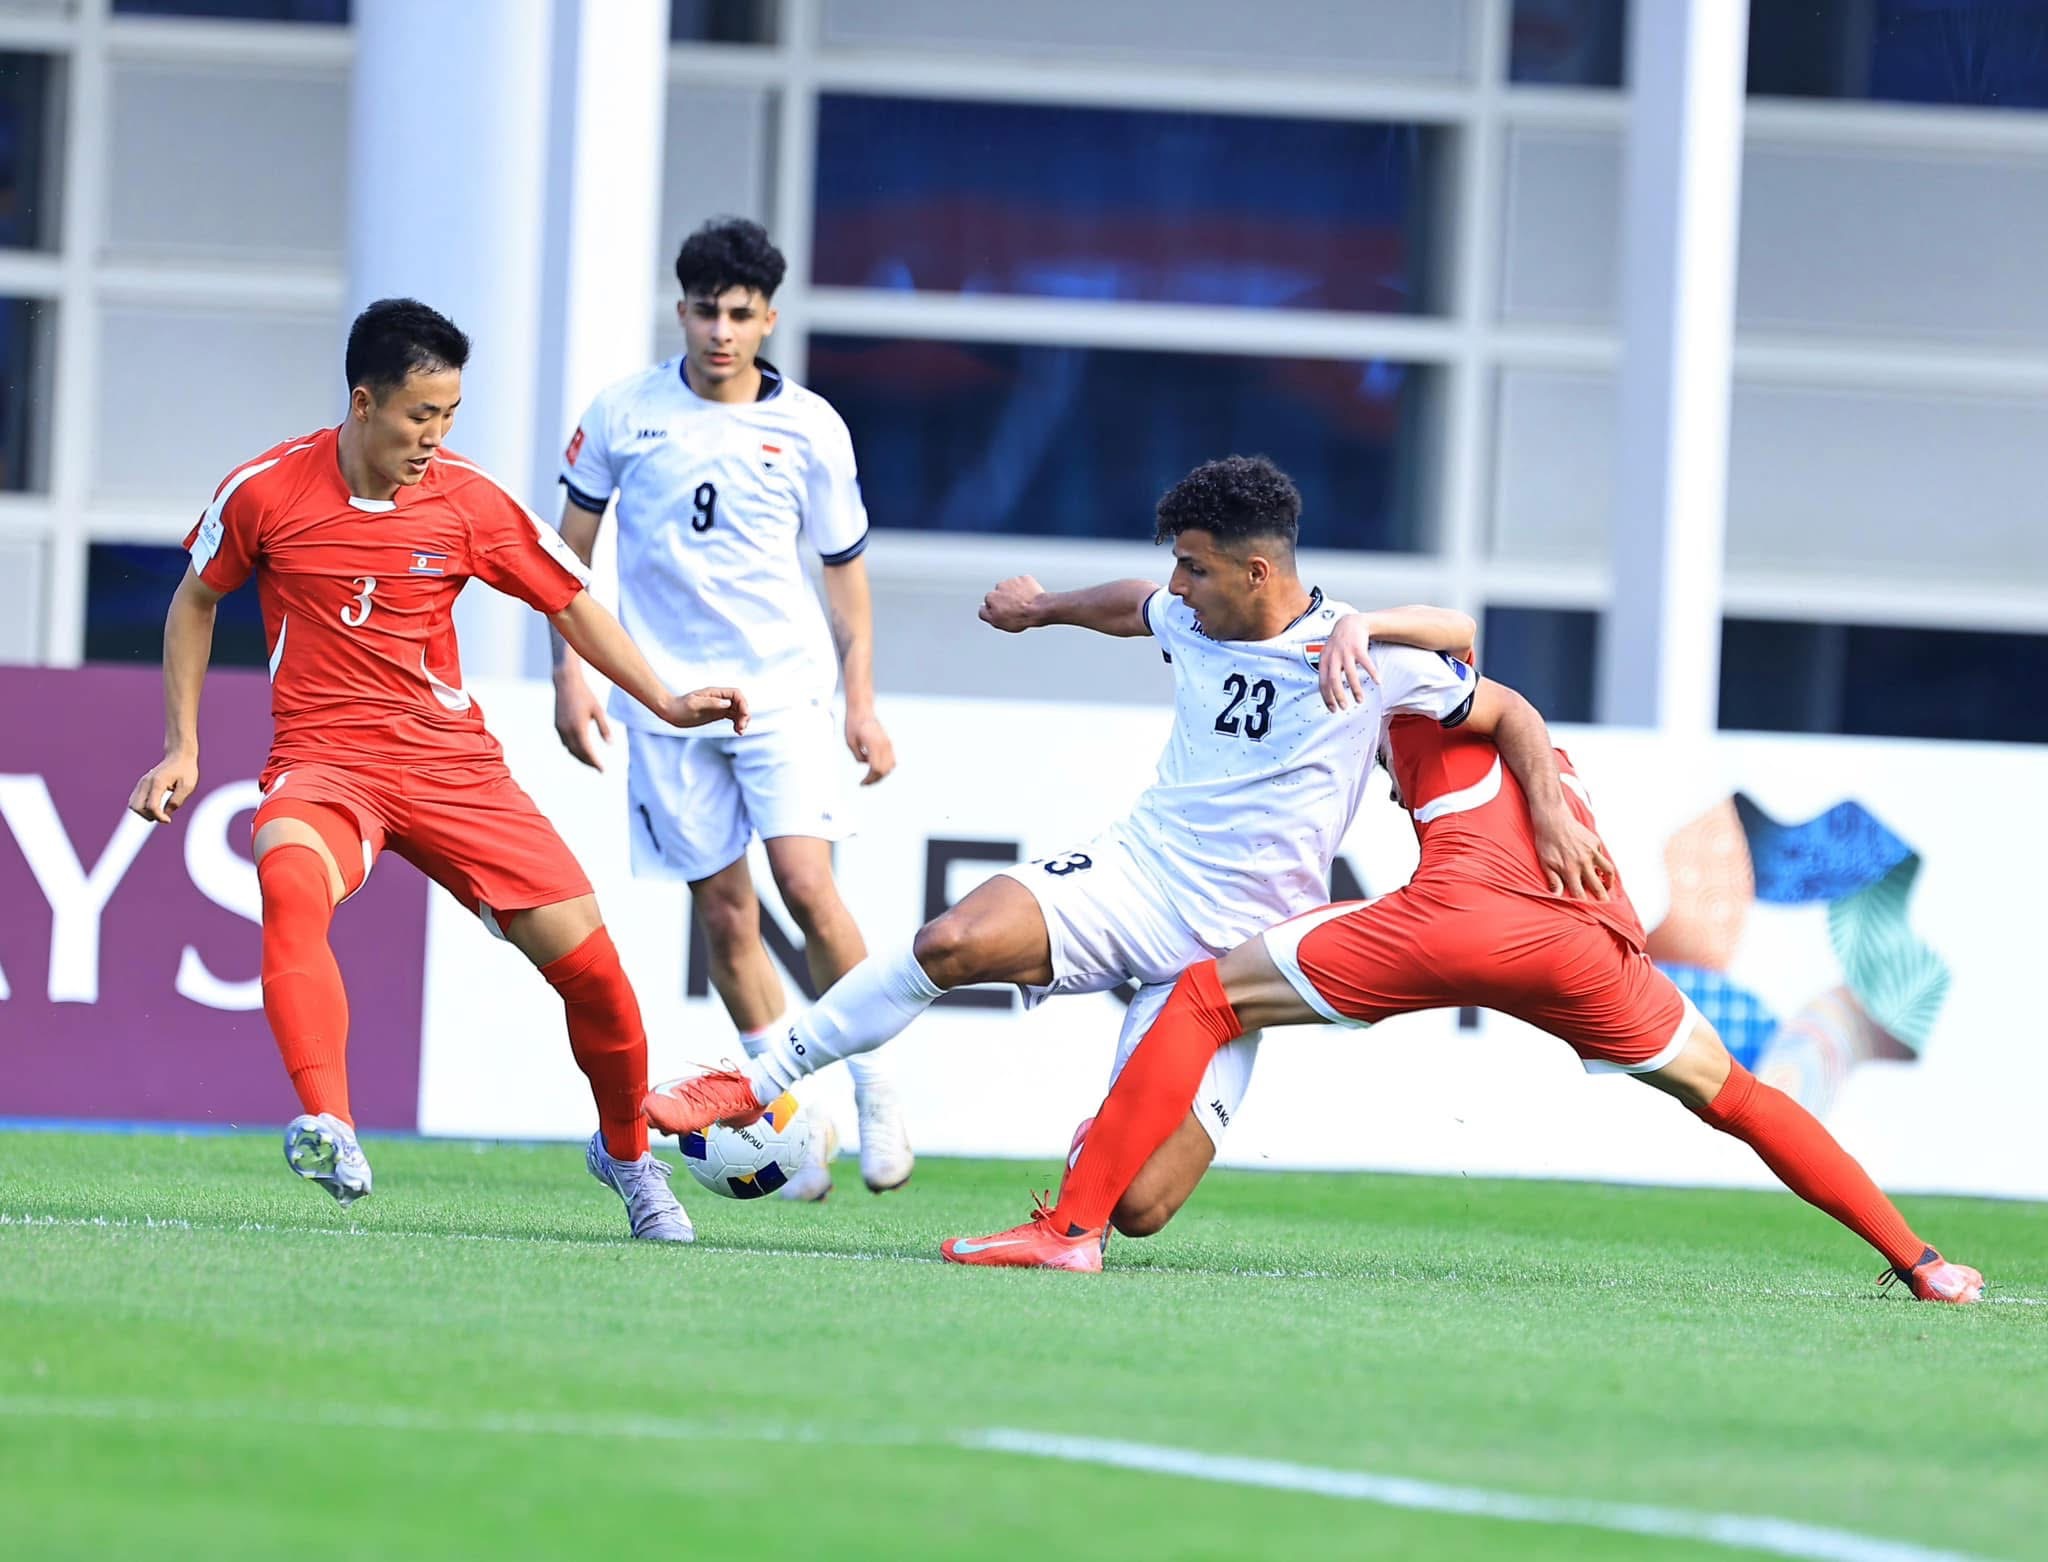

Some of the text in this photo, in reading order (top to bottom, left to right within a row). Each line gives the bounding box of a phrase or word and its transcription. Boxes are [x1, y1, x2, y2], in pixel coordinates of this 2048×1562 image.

[692, 482, 717, 532] 9
[340, 576, 377, 627] 3
[1214, 672, 1278, 742] 23
[0, 773, 263, 1011] YS
[1210, 1099, 1230, 1127] JAKO
